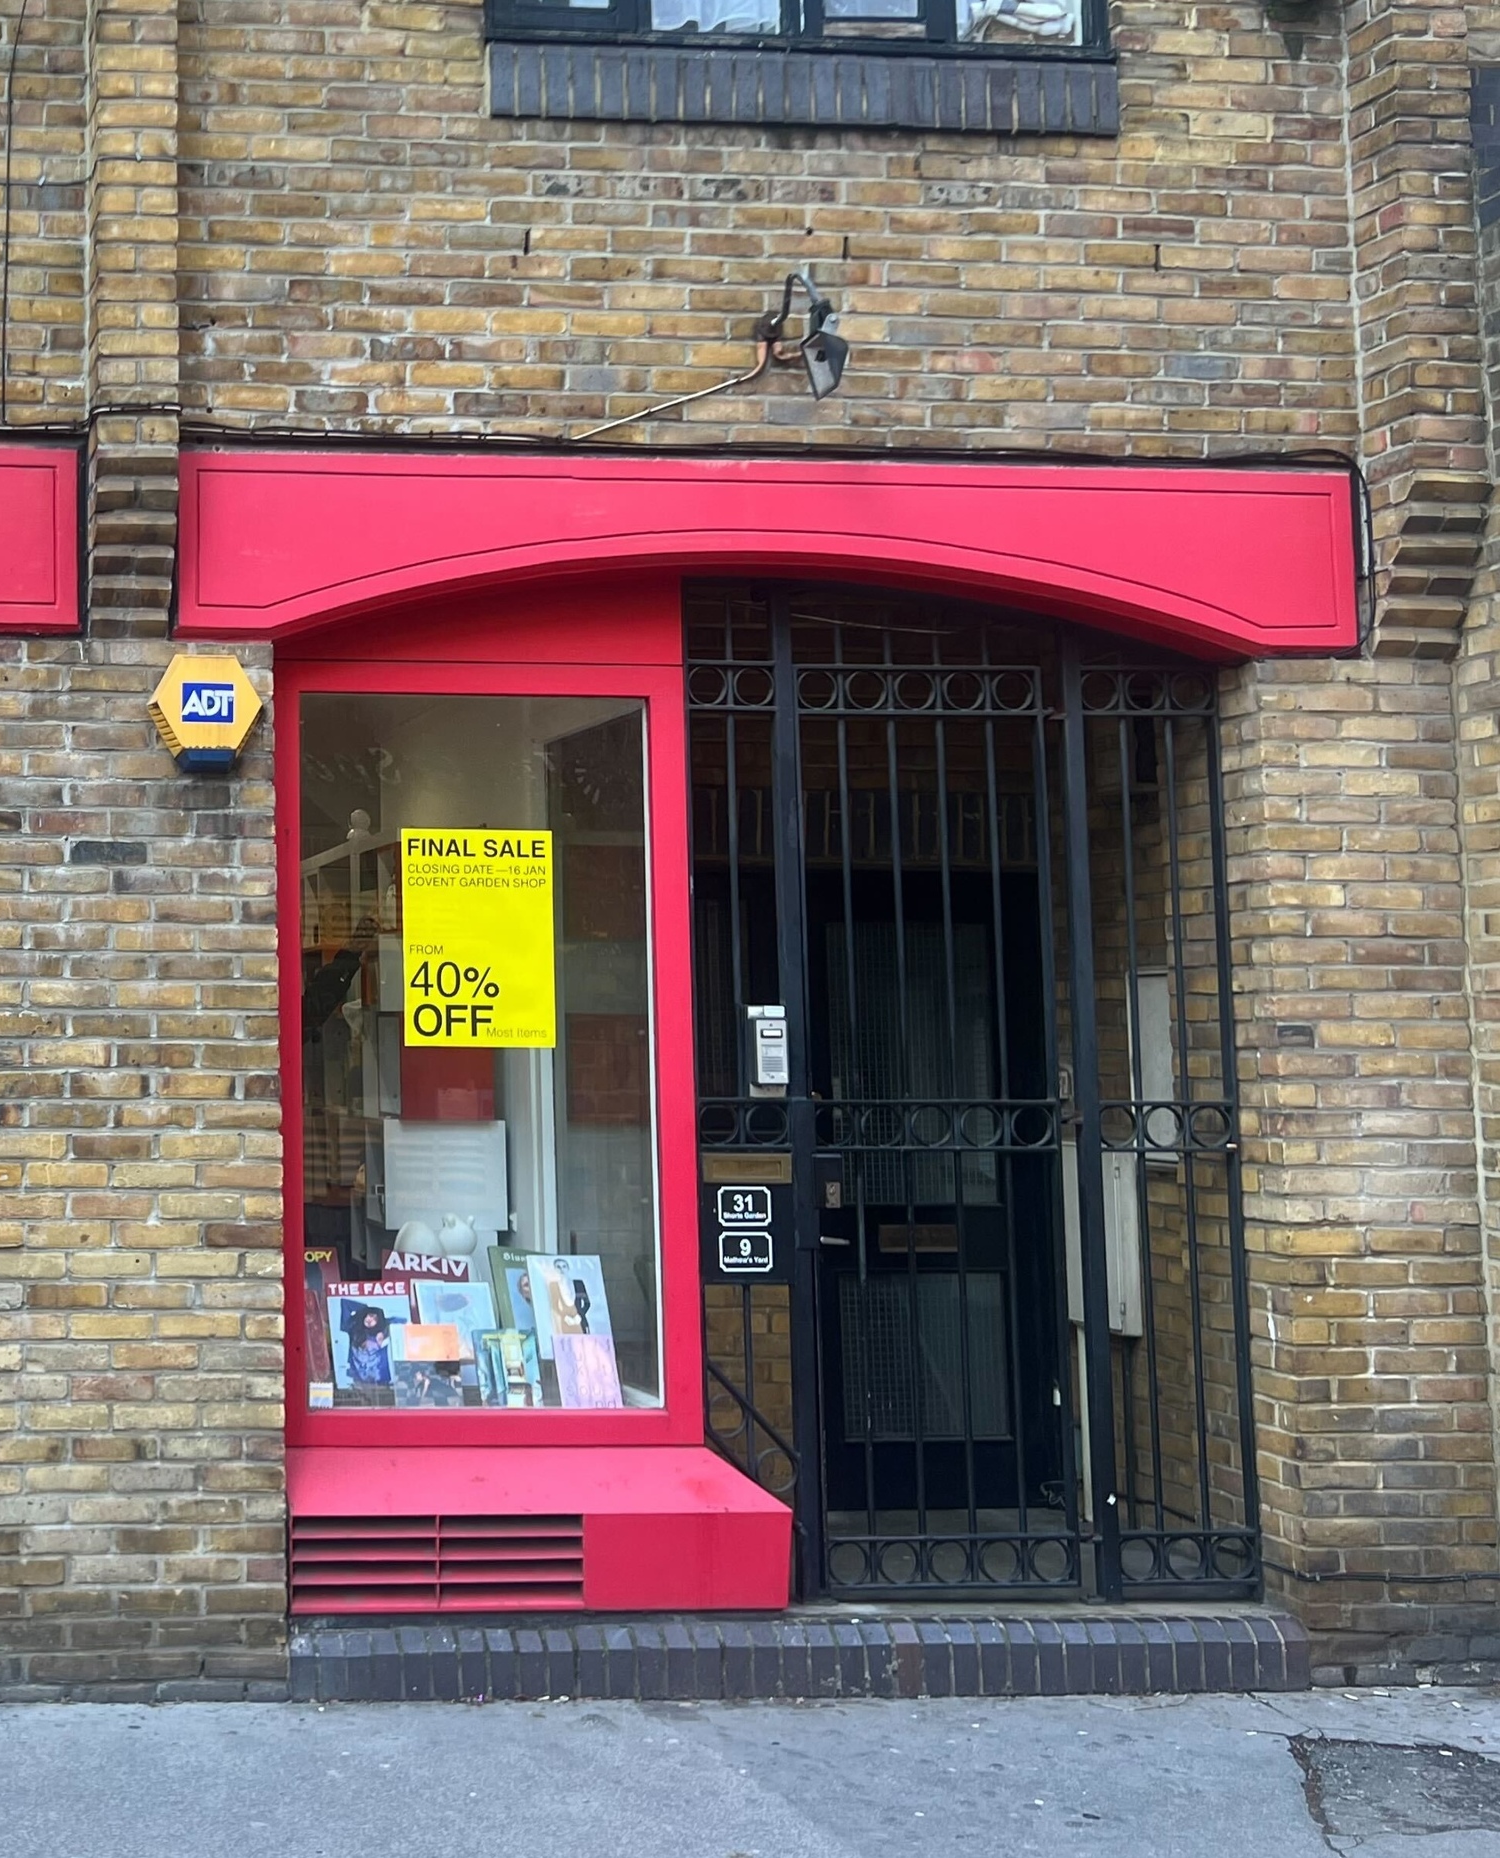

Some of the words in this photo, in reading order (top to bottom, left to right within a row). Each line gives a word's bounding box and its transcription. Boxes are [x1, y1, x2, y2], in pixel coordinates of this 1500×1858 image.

[181, 689, 234, 717] ADT
[407, 838, 476, 857] FINAL
[483, 839, 546, 858] SALE
[407, 863, 460, 874] CLOSING
[463, 864, 494, 875] DATE
[523, 866, 546, 876] JAN
[407, 876, 456, 887] COVENT
[459, 877, 510, 888] GARDEN
[513, 878, 546, 888] SHOP
[409, 944, 444, 955] FROM
[410, 960, 500, 998] 40%
[413, 1003, 494, 1037] OFF
[486, 1027, 513, 1038] Most
[516, 1028, 547, 1038] Items
[733, 1194, 753, 1212] 31
[739, 1238, 752, 1256] 9
[385, 1251, 468, 1277] ARKIV
[328, 1284, 360, 1295] THE
[364, 1282, 406, 1295] FACE
